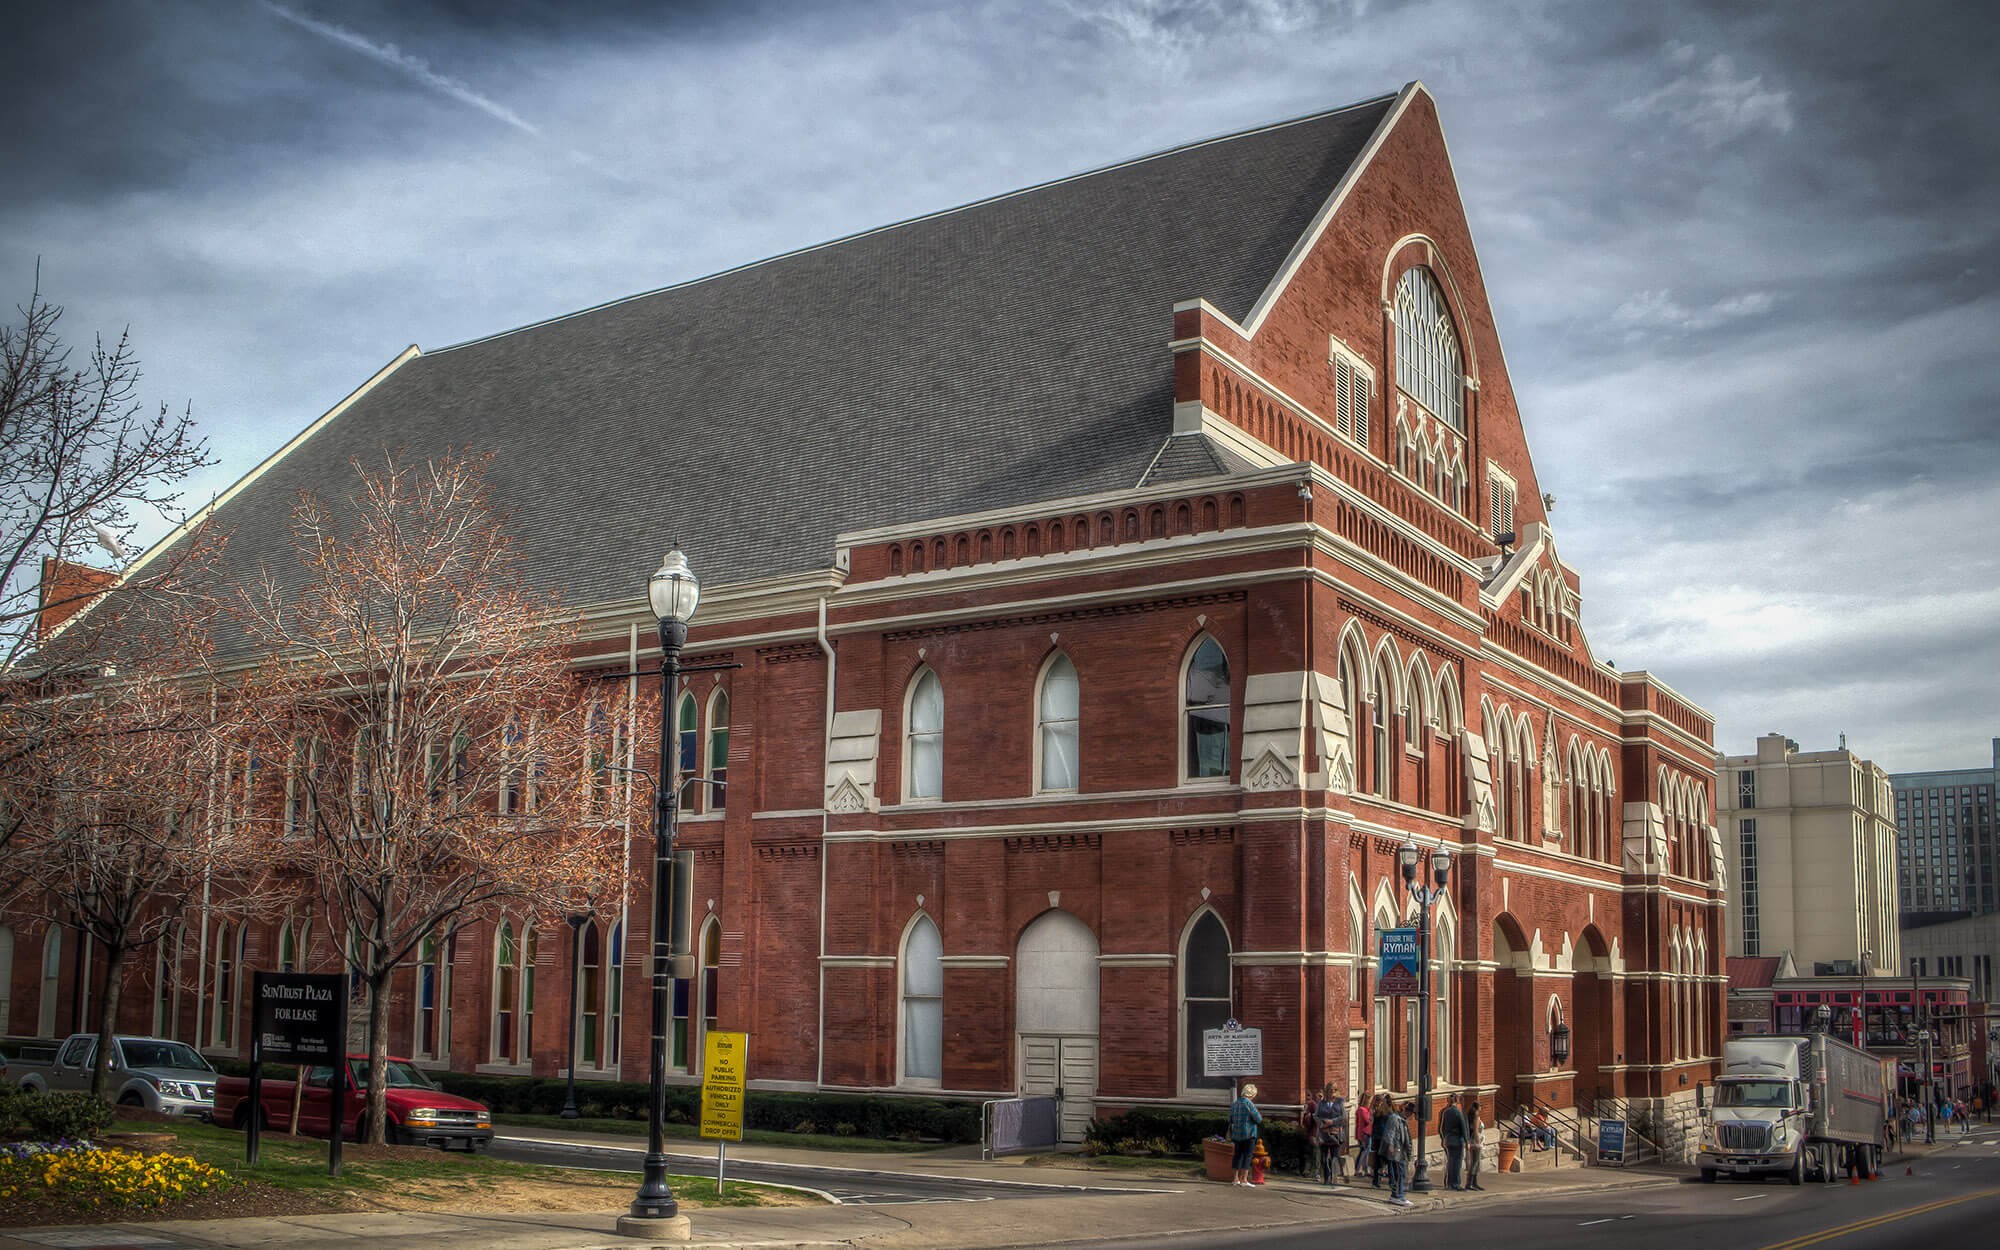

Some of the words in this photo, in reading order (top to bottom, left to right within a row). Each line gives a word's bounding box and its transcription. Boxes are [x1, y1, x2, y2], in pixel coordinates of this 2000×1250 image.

[1386, 935, 1401, 943] TOUR
[1403, 935, 1414, 943] THE
[1383, 943, 1416, 953] RYMAN
[305, 985, 333, 1001] PLAZA
[275, 1008, 291, 1020] FOR
[292, 1009, 318, 1021] LEASE
[705, 1085, 742, 1093] AUTHORIZED
[703, 1120, 740, 1128] COMMERCIAL
